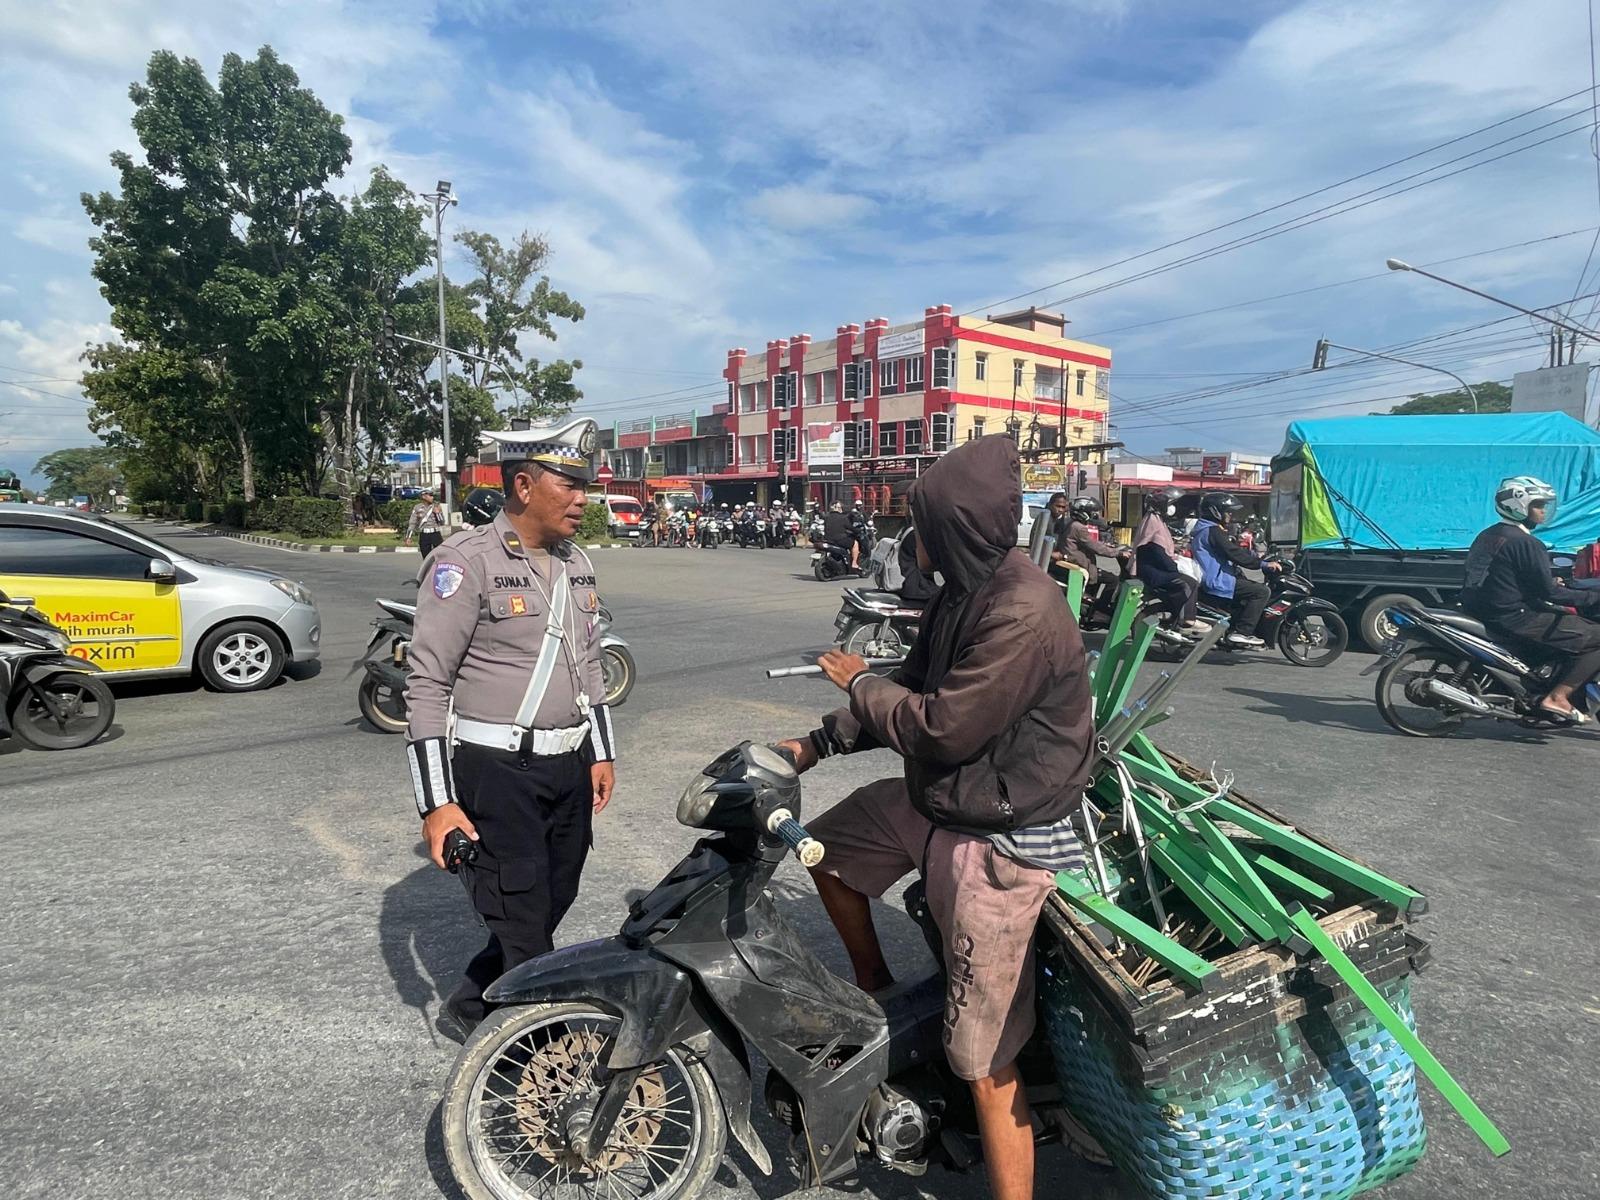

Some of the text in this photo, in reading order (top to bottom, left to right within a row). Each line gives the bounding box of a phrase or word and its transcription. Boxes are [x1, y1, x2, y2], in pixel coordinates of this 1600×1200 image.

[494, 576, 532, 589] SUNAJI
[55, 611, 136, 623] MaximCar
[87, 624, 135, 636] murah
